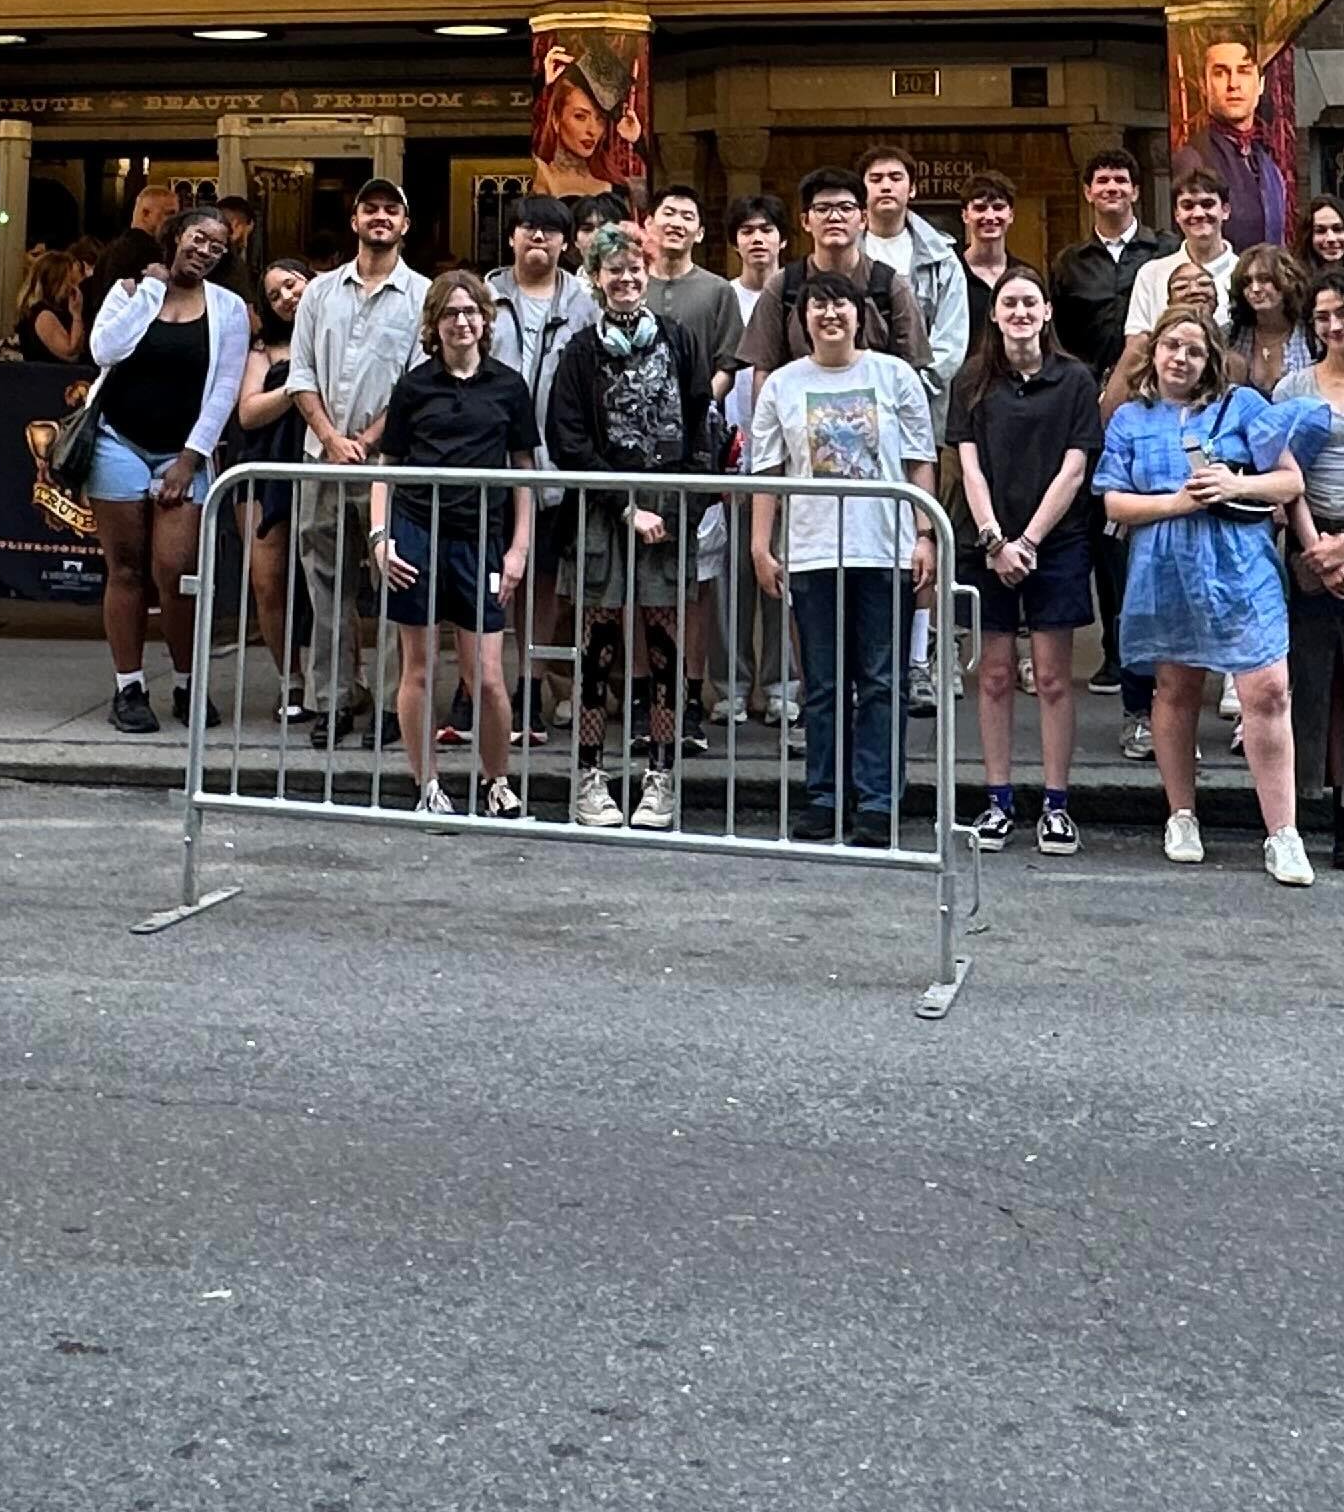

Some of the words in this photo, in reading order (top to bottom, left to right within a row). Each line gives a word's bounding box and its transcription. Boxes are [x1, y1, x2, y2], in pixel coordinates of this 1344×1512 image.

[142, 94, 263, 111] BEAUTY
[311, 92, 464, 109] FREEDOM
[933, 160, 974, 177] BECK
[916, 179, 961, 195] ATRE
